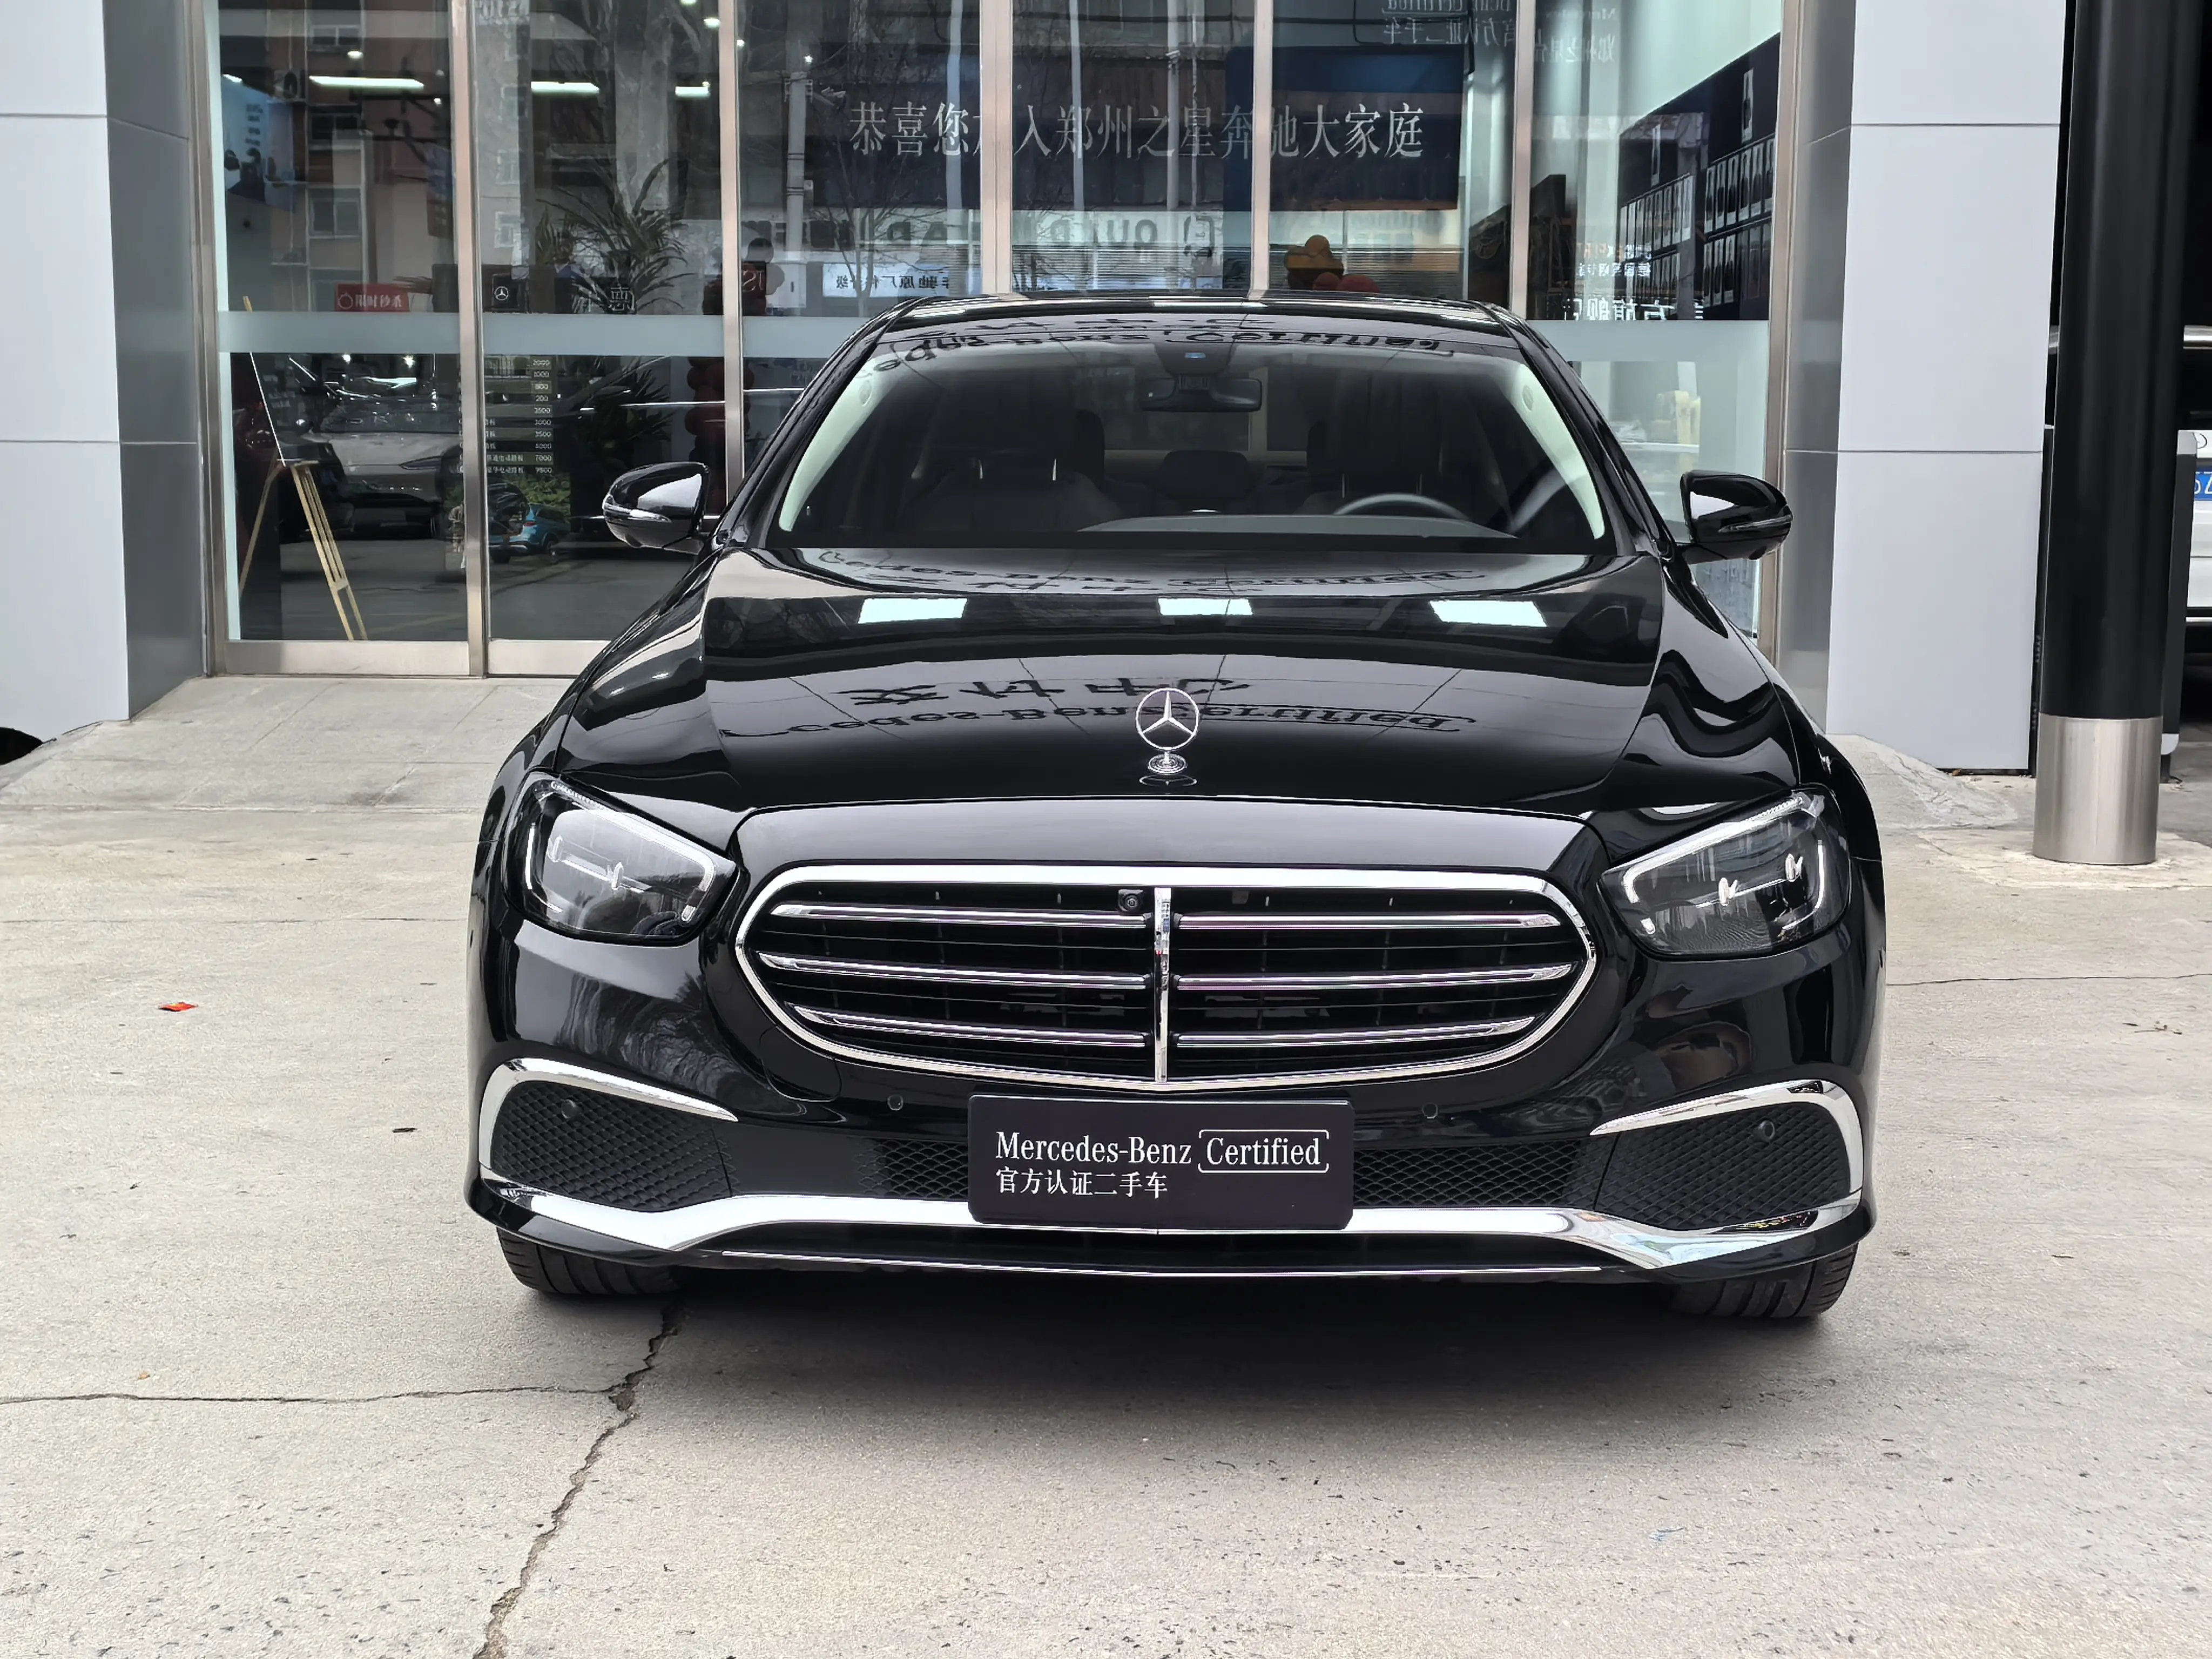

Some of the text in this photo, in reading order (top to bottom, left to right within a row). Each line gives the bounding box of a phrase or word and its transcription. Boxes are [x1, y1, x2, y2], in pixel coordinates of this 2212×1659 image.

[849, 101, 1425, 160] 恭喜您入郑州之星奔驰大家庭
[995, 1131, 1321, 1166] Mercedes-Benz Certified
[995, 1165, 1168, 1199] 官方认证二手车
